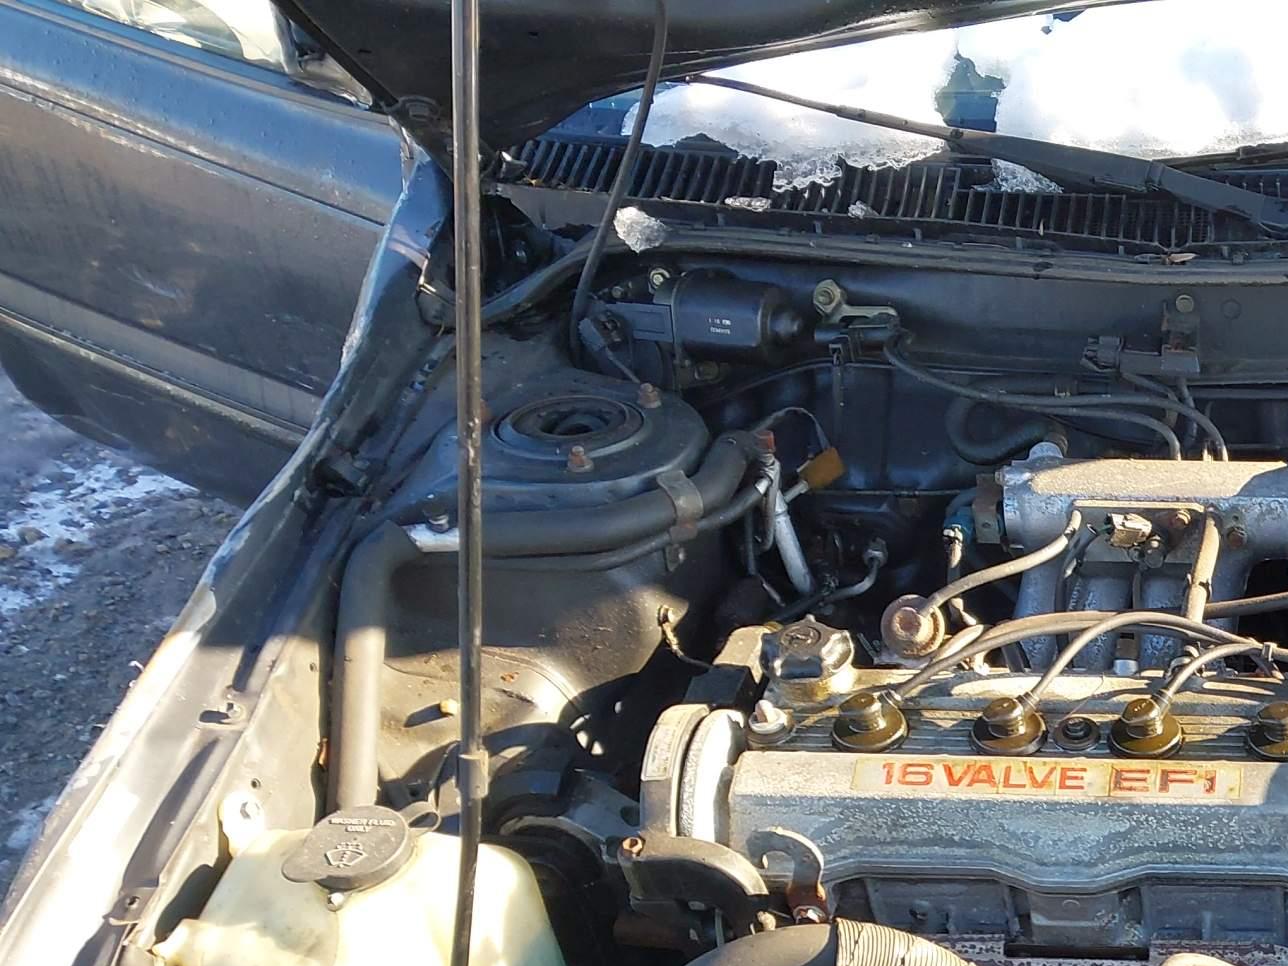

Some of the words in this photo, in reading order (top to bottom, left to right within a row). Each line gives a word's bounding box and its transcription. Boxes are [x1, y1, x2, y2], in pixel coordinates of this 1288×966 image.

[882, 762, 936, 786] 16
[942, 763, 1086, 790] VALVE
[1113, 769, 1217, 793] EFI
[345, 825, 372, 833] ONLY
